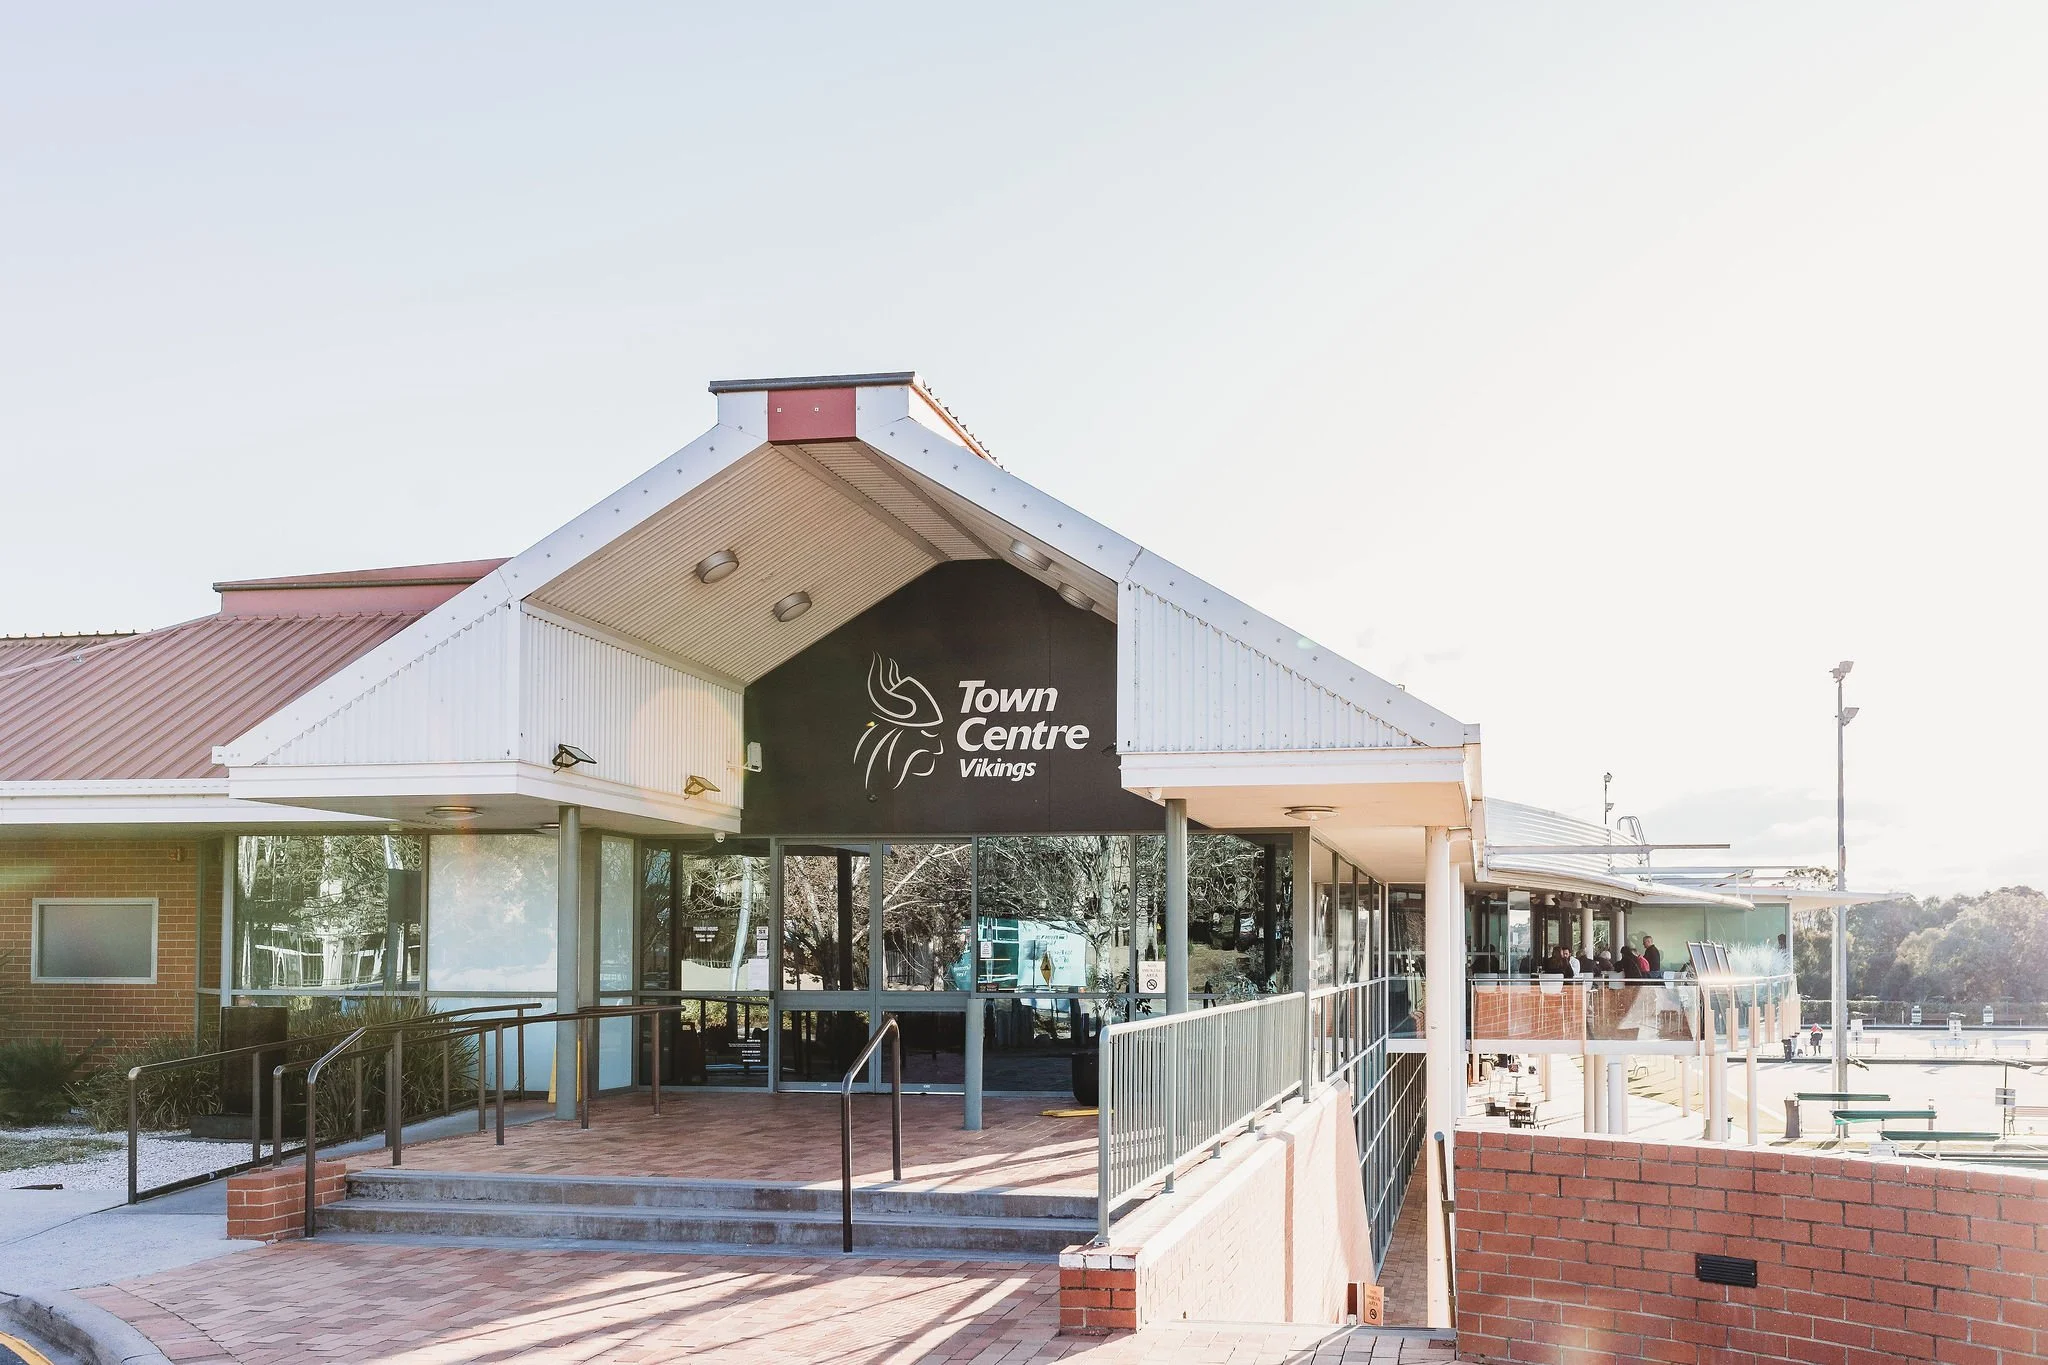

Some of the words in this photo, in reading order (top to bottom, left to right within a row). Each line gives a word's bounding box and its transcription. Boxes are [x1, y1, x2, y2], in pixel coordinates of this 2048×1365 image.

[958, 680, 1059, 714] Town
[956, 716, 1090, 752] Centre
[959, 757, 1037, 782] Vikings
